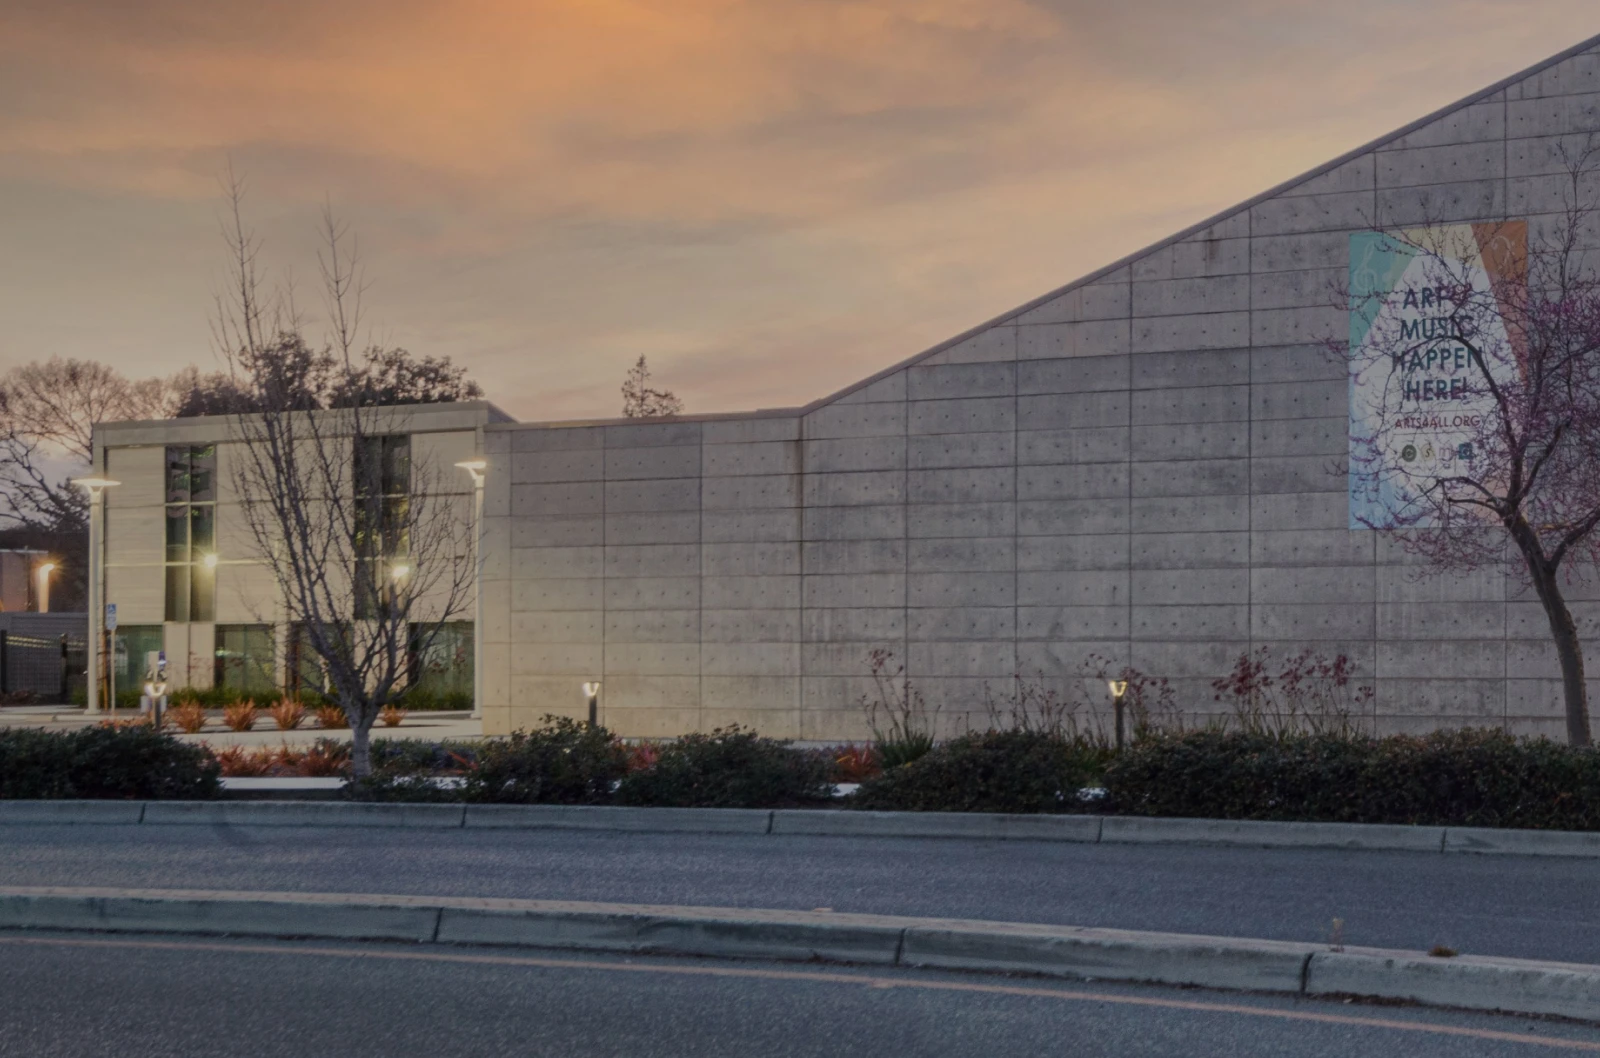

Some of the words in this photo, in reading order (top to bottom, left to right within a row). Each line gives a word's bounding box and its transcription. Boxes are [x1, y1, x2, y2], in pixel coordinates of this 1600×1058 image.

[1403, 287, 1445, 309] ART
[1400, 315, 1474, 340] MUSIC
[1392, 347, 1482, 372] HAPPEN
[1406, 376, 1467, 402] HERE!
